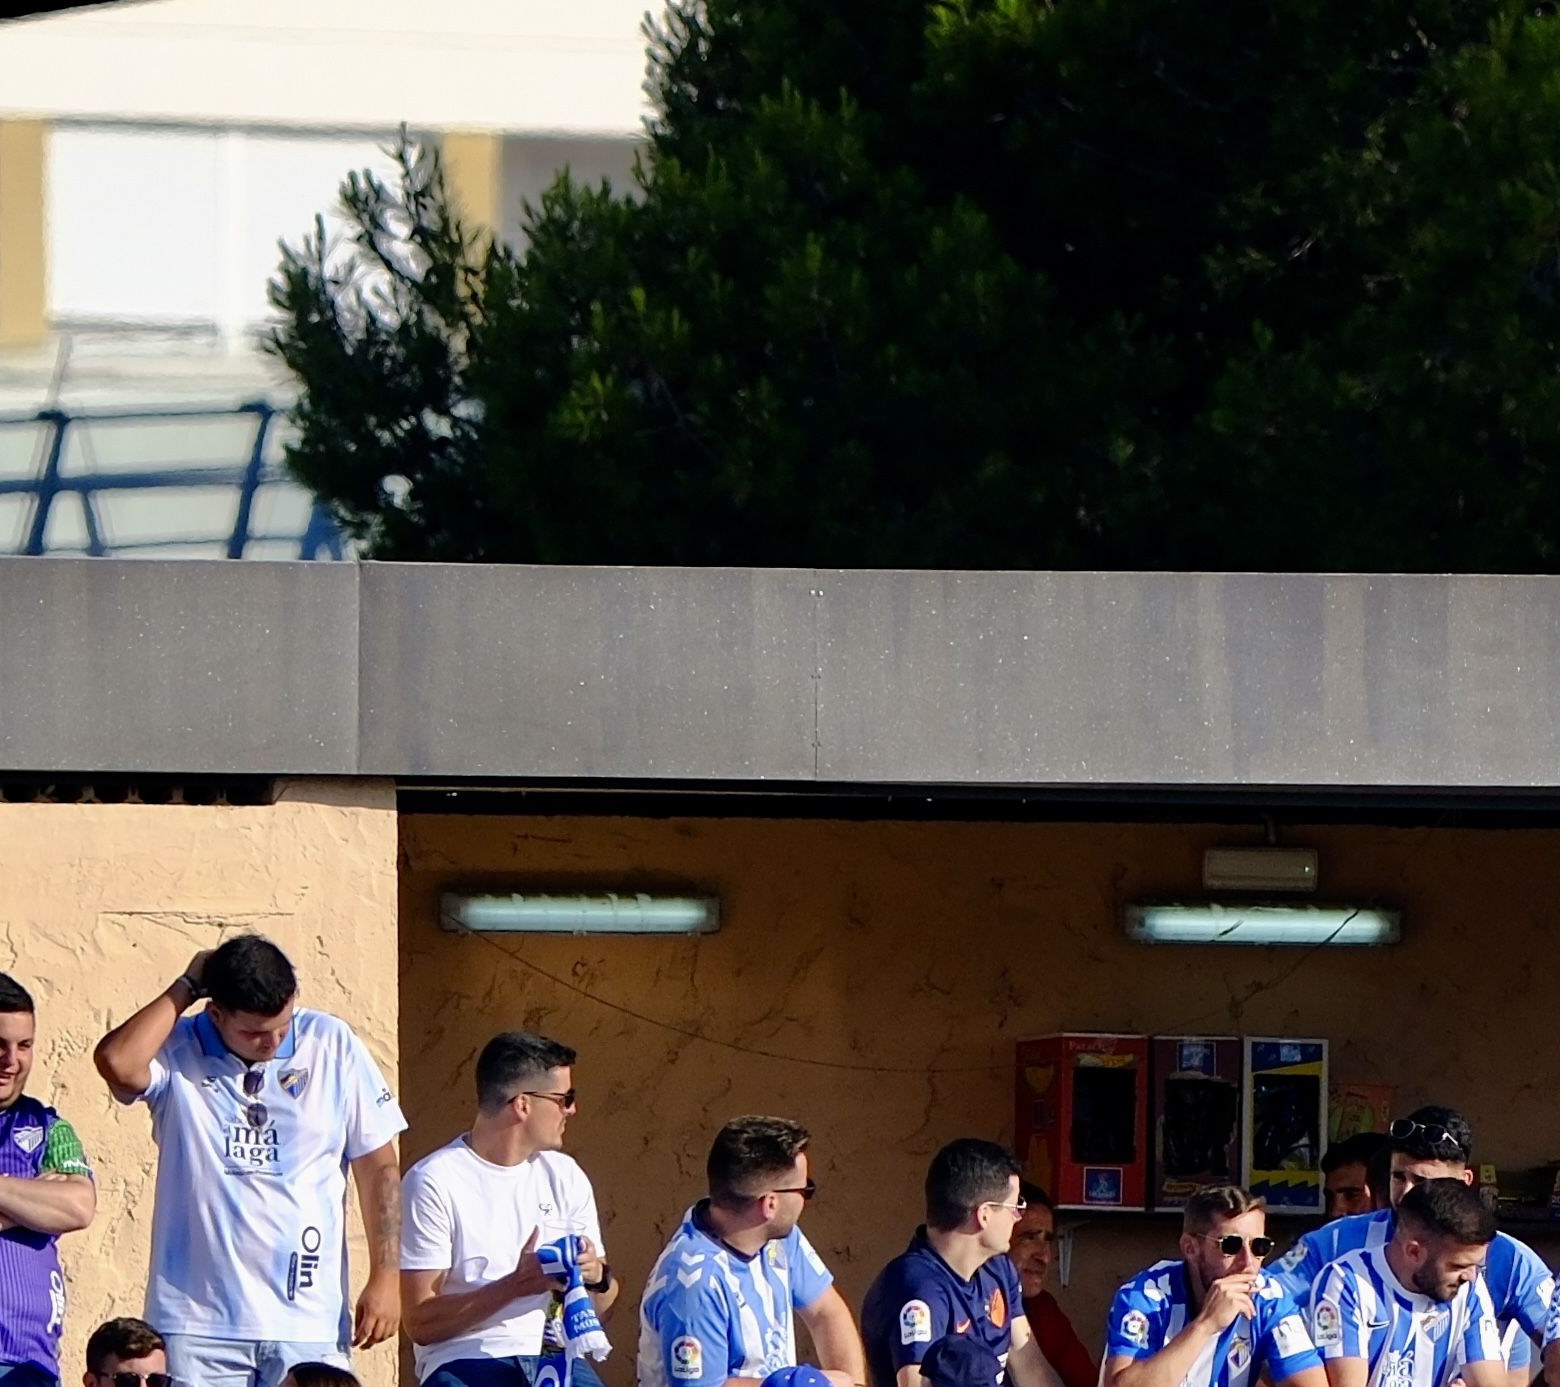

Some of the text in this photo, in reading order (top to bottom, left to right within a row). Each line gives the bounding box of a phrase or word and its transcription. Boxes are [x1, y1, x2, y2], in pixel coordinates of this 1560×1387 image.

[233, 1120, 282, 1145] má
[225, 1142, 281, 1167] laga
[300, 1225, 322, 1288] Olin
